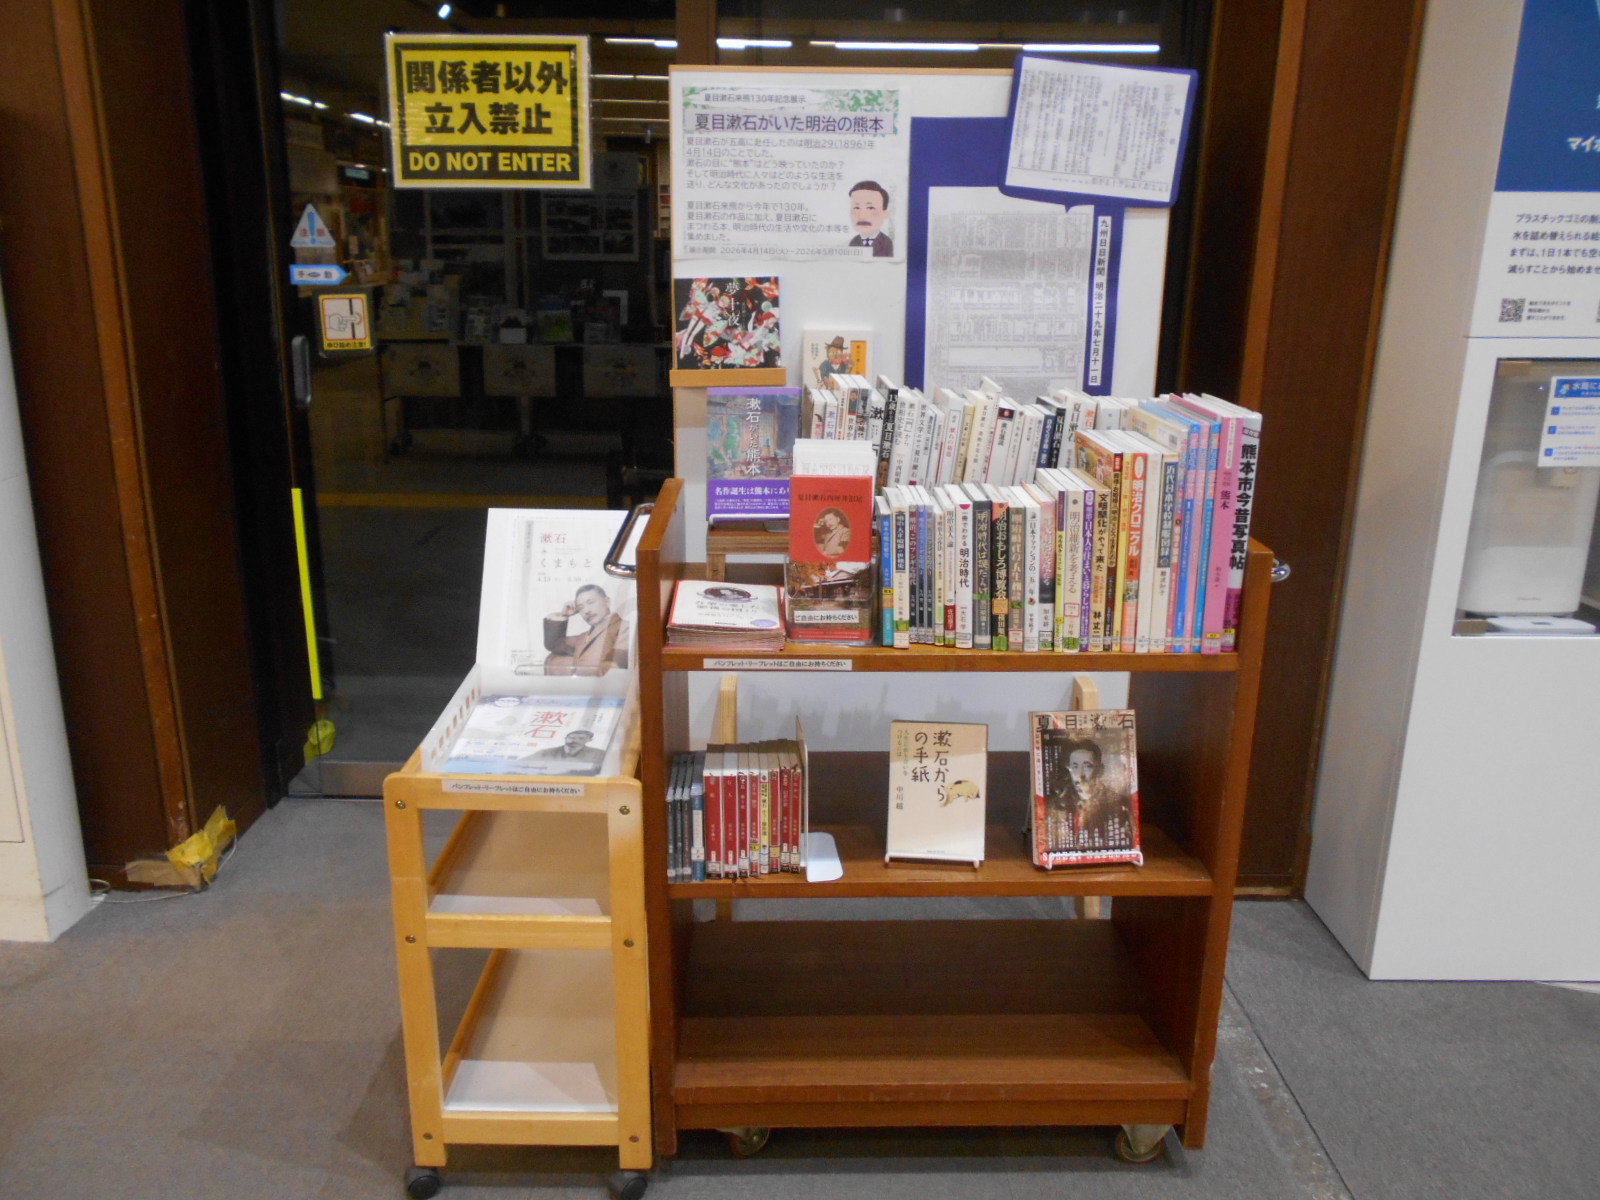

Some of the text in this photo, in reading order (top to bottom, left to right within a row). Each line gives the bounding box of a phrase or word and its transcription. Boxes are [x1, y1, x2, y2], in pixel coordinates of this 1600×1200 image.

[405, 60, 568, 95] 関係者以外
[424, 102, 553, 136] 立入禁止
[695, 113, 884, 134] 夏目漱石がいた明治の熊本
[409, 152, 572, 173] DO NOT ENTER
[1516, 213, 1600, 224] プラスチックゴミの削
[1510, 248, 1600, 258] まずは、1日1本でも空
[724, 281, 741, 326] 夢十夜
[1089, 218, 1110, 384] 九州日日新聞 明治二十九年七月十一日
[744, 397, 761, 476] 漱石がいた熊本
[1127, 479, 1144, 557] 明治クロニクル
[1228, 443, 1259, 570] 熊本市今昔写真帖
[539, 532, 567, 544] 漱石
[1095, 493, 1108, 572] 文明開化がやって来た
[539, 557, 593, 569] くまもと
[959, 547, 970, 589] 明治時代
[794, 613, 858, 622] ご自由にお持ちください
[524, 711, 569, 739] 漱石
[1036, 712, 1135, 732] 夏目漱石
[911, 730, 931, 783] の手紙
[932, 731, 952, 803] 漱石から
